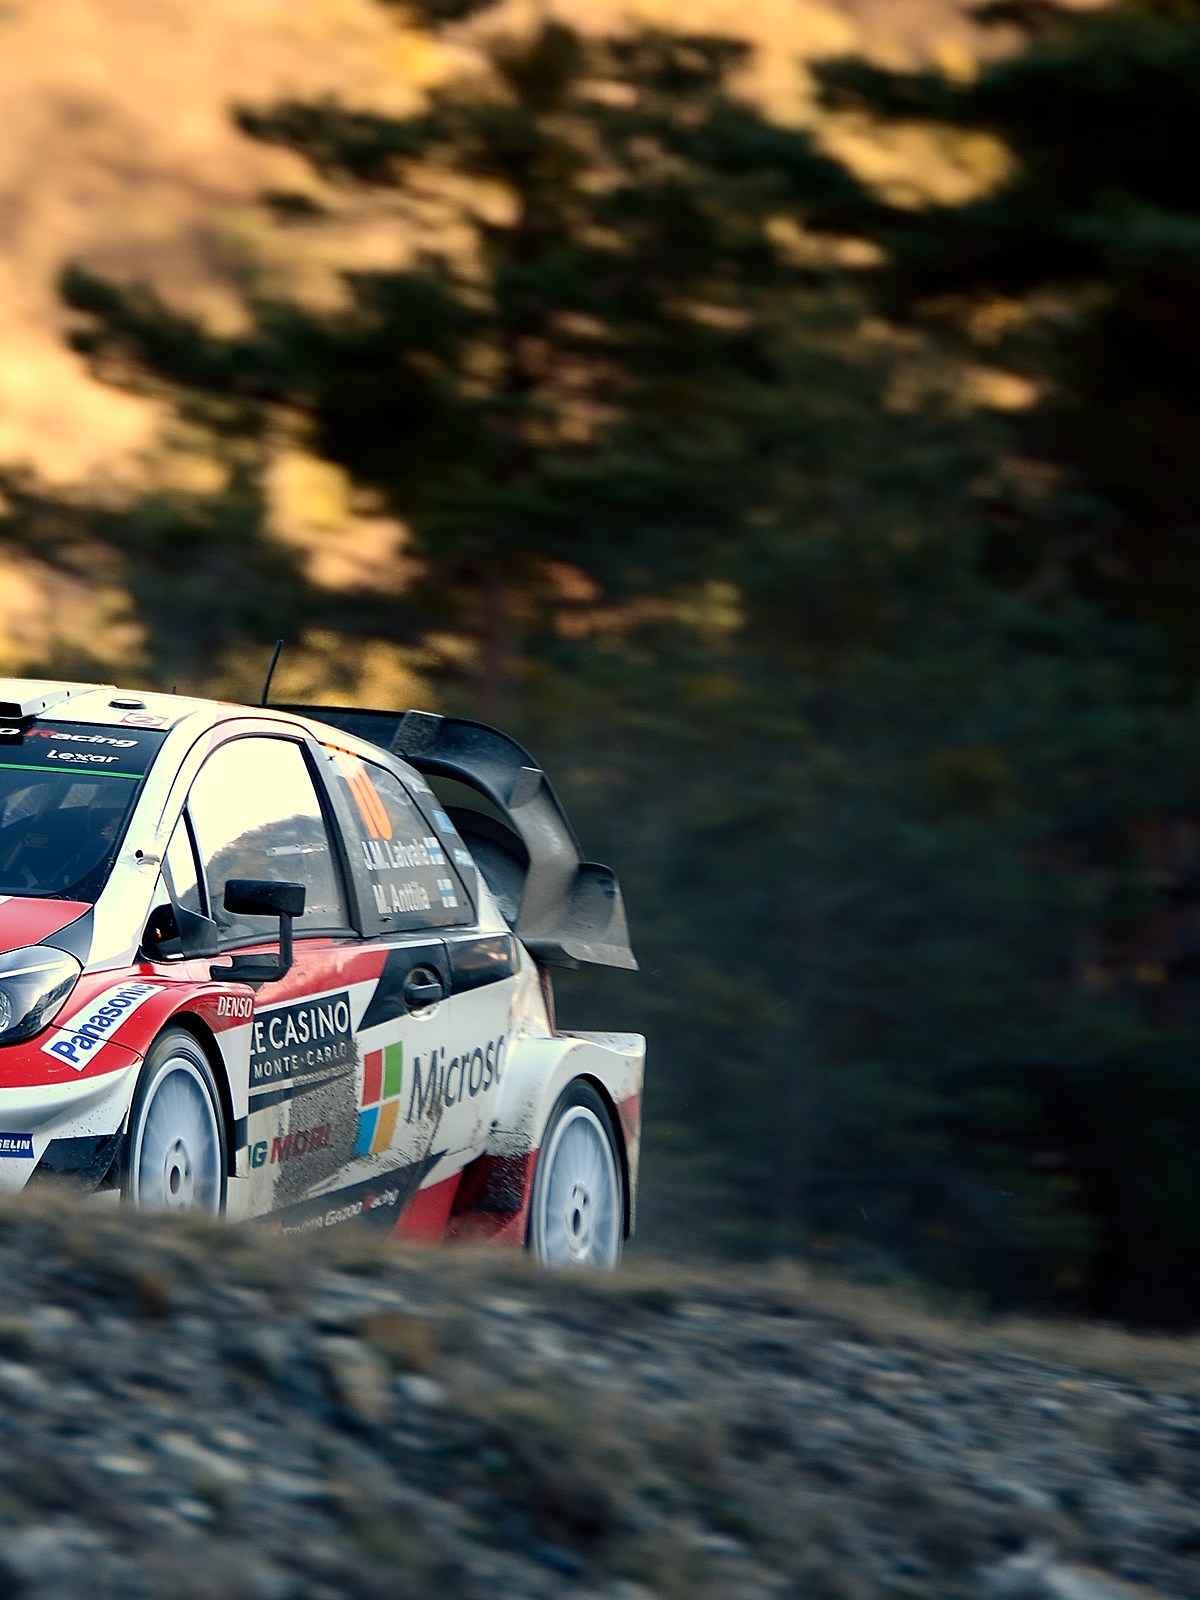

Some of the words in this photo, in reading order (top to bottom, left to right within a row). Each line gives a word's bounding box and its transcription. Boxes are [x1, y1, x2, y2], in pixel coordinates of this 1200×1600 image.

[24, 728, 139, 748] Racing
[46, 749, 120, 764] Lexar
[216, 995, 254, 1019] DENSO
[50, 982, 156, 1064] Panasonic
[268, 1000, 350, 1050] CASINO
